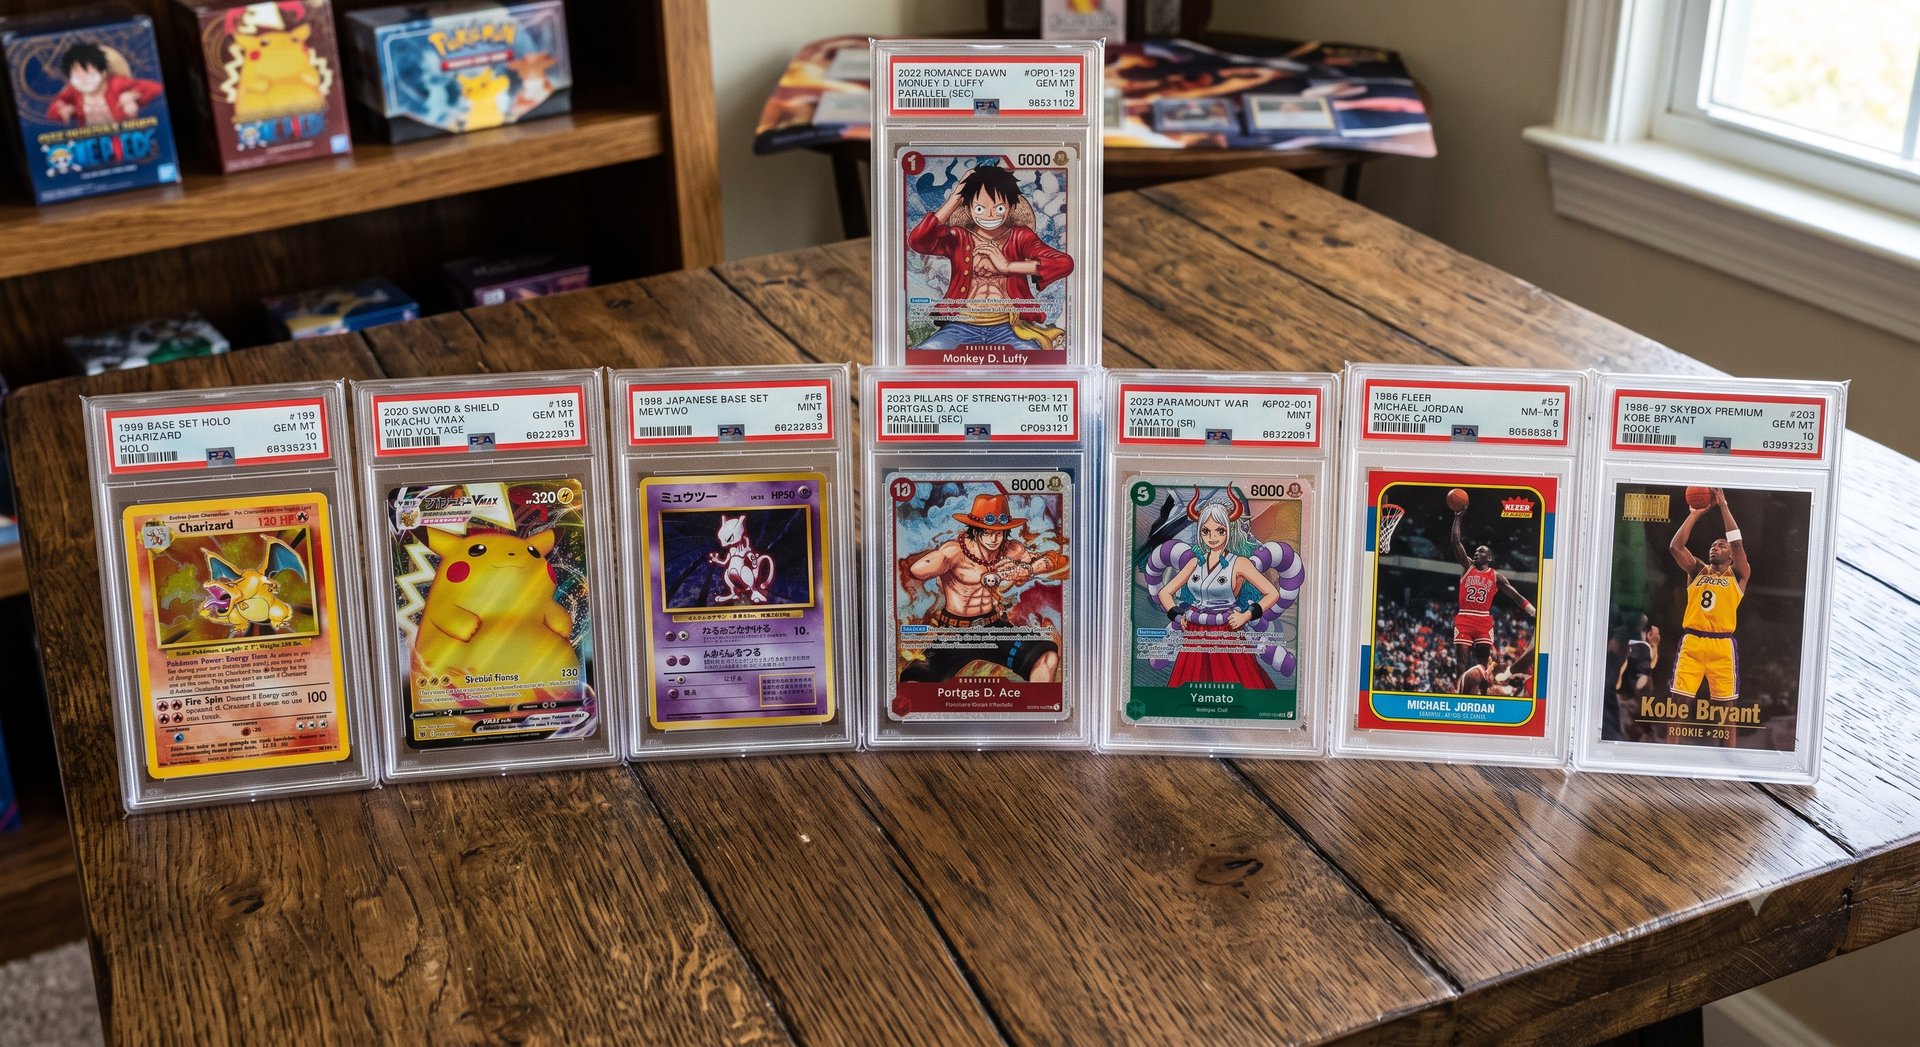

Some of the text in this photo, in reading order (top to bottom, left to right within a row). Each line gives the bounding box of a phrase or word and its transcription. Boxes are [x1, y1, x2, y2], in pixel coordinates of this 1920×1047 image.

[898, 69, 1007, 78] 2022 ROMANCE DAWN
[898, 90, 974, 98] PARALLEL (SEC)
[943, 354, 1028, 365] Monkey D. Luffy
[639, 394, 768, 405] 1998 JAPANESE BASE SET
[805, 393, 822, 401] #F6
[914, 394, 953, 402] PILLARS
[956, 394, 969, 402] OF
[1402, 394, 1431, 402] FLEER
[798, 403, 822, 411] MINT
[1130, 398, 1249, 407] 2023 PARAMOUNT WAR
[384, 403, 500, 416] 2020 SWORD & SHIELD
[639, 407, 688, 416] MEWTWO
[1028, 404, 1050, 412] GEM
[1130, 408, 1174, 416] YAMATO
[1374, 403, 1464, 413] MICHAEL JORDAN
[1521, 408, 1559, 417] NM-MT
[1625, 403, 1763, 417] 1986-97 SKYBOX PREMIUM
[533, 409, 573, 419] GEM MT
[887, 415, 963, 423] PARALLEL (SEC)
[1287, 411, 1311, 419] MINT
[1374, 413, 1442, 423] ROOKIE CARD
[1624, 414, 1696, 424] KOBE BRYANT
[1790, 411, 1815, 419] #203
[119, 417, 230, 431] 1999 BASE SET HOLO
[385, 415, 465, 426] PIKACHU VMAX
[564, 420, 575, 428] 16
[1130, 418, 1196, 428] YAMATO (SR)
[1552, 419, 1559, 427] 8
[1772, 420, 1814, 430] GEM MT
[273, 422, 315, 433] GEM MT
[386, 426, 464, 436] VIVID VOLTAGE
[1624, 424, 1660, 433] ROOKIE
[120, 431, 181, 443] CHARIZARD
[120, 444, 149, 453] HOLO
[1012, 478, 1044, 491] 8000
[532, 492, 556, 504] 320
[661, 492, 717, 503] ミュウツー
[771, 490, 795, 499] HP50
[1137, 486, 1150, 501] 5
[472, 494, 498, 506] VMAX
[179, 520, 233, 532] Charizard
[259, 516, 294, 527] 120 HP
[1466, 586, 1488, 603] 23
[1701, 590, 1715, 612] 8
[226, 654, 249, 662] Energy
[308, 691, 327, 703] 100
[938, 688, 1020, 699] Portgas D. Ace
[1191, 693, 1234, 703] Yamato
[186, 697, 201, 706] Fire
[205, 696, 223, 706] Spin
[1408, 700, 1495, 713] MICHAEL JORDAN
[1641, 696, 1761, 725] Kobe Bryant
[1669, 727, 1703, 737] ROOKIE
